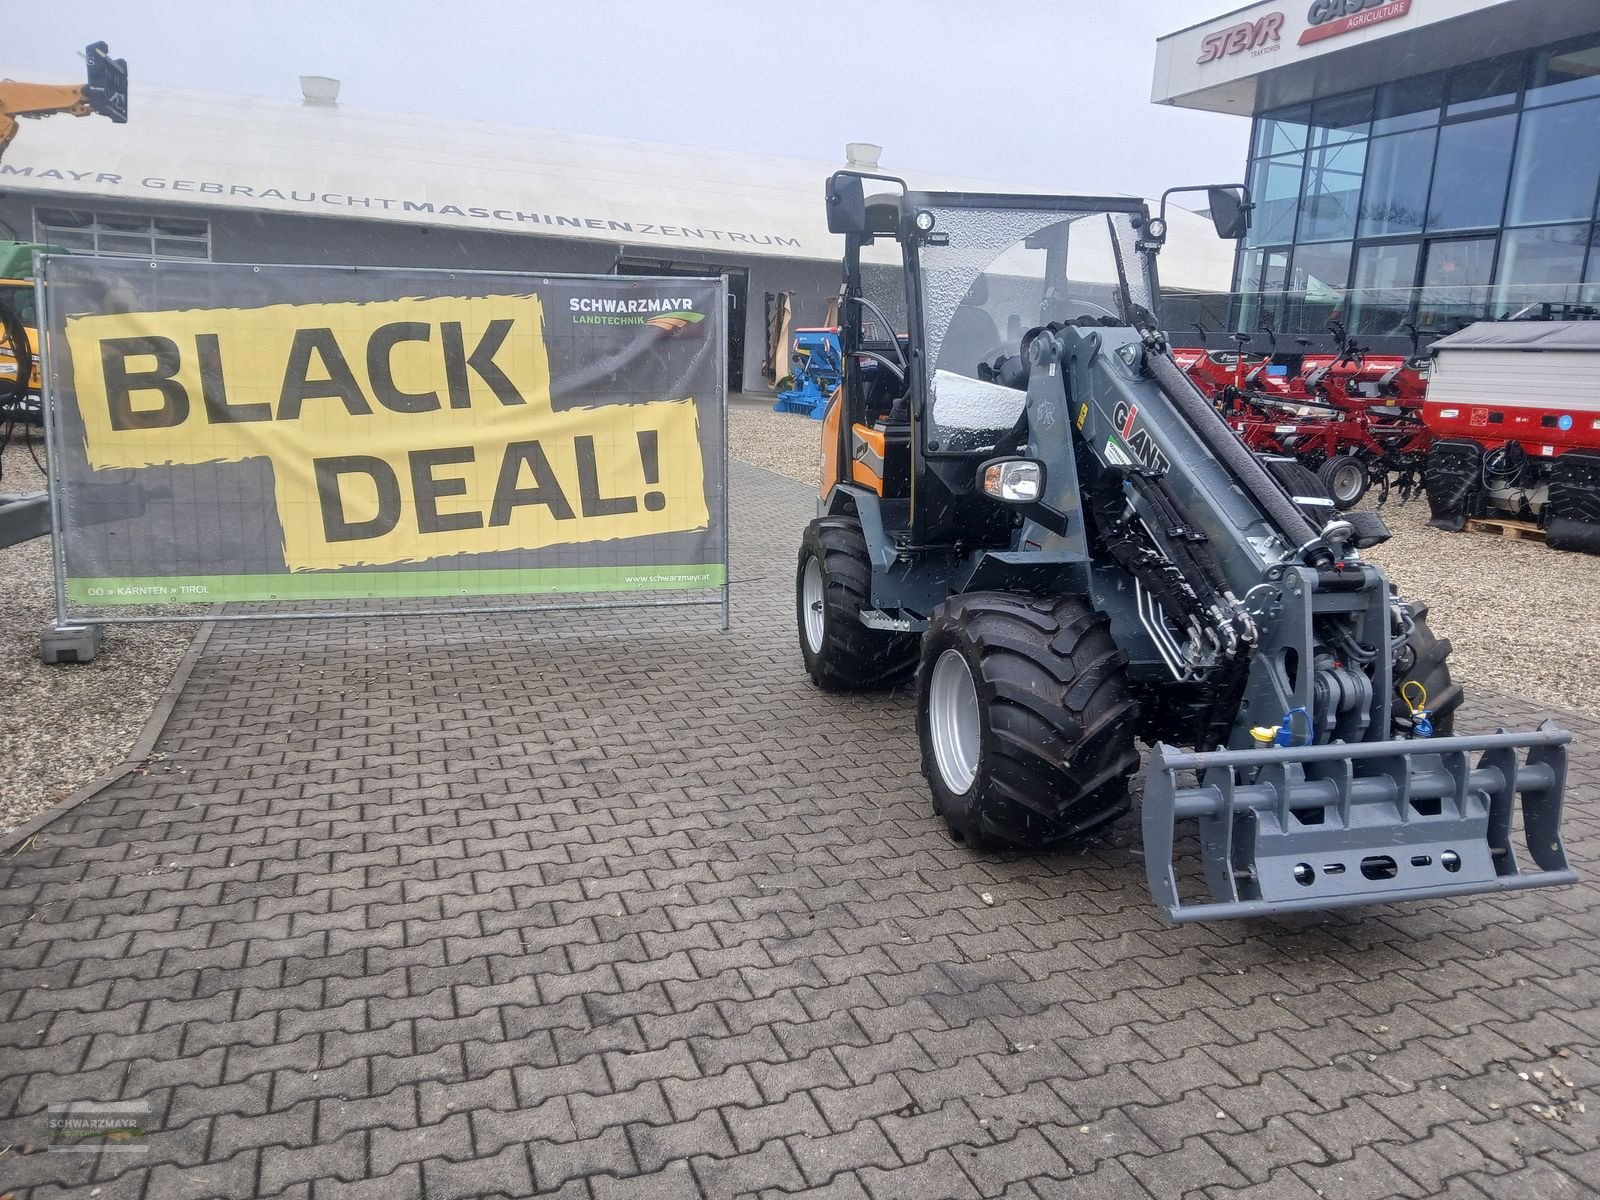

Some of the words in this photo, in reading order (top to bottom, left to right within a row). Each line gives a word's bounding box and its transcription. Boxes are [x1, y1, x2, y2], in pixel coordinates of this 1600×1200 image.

[1346, 3, 1405, 29] AGRICULTURE
[1196, 12, 1285, 64] STEYR
[1250, 43, 1281, 59] TRAKTOREN
[141, 177, 801, 248] GEBRAUCHTMASCHINENZENTRUM
[569, 298, 693, 313] SCHWARZMAYR
[572, 315, 645, 326] LANDTECHNIK
[98, 318, 528, 432] BLACK
[312, 429, 667, 544] DEAL!
[625, 574, 710, 583] www.schwarzmayr.at
[180, 585, 210, 594] TIROL
